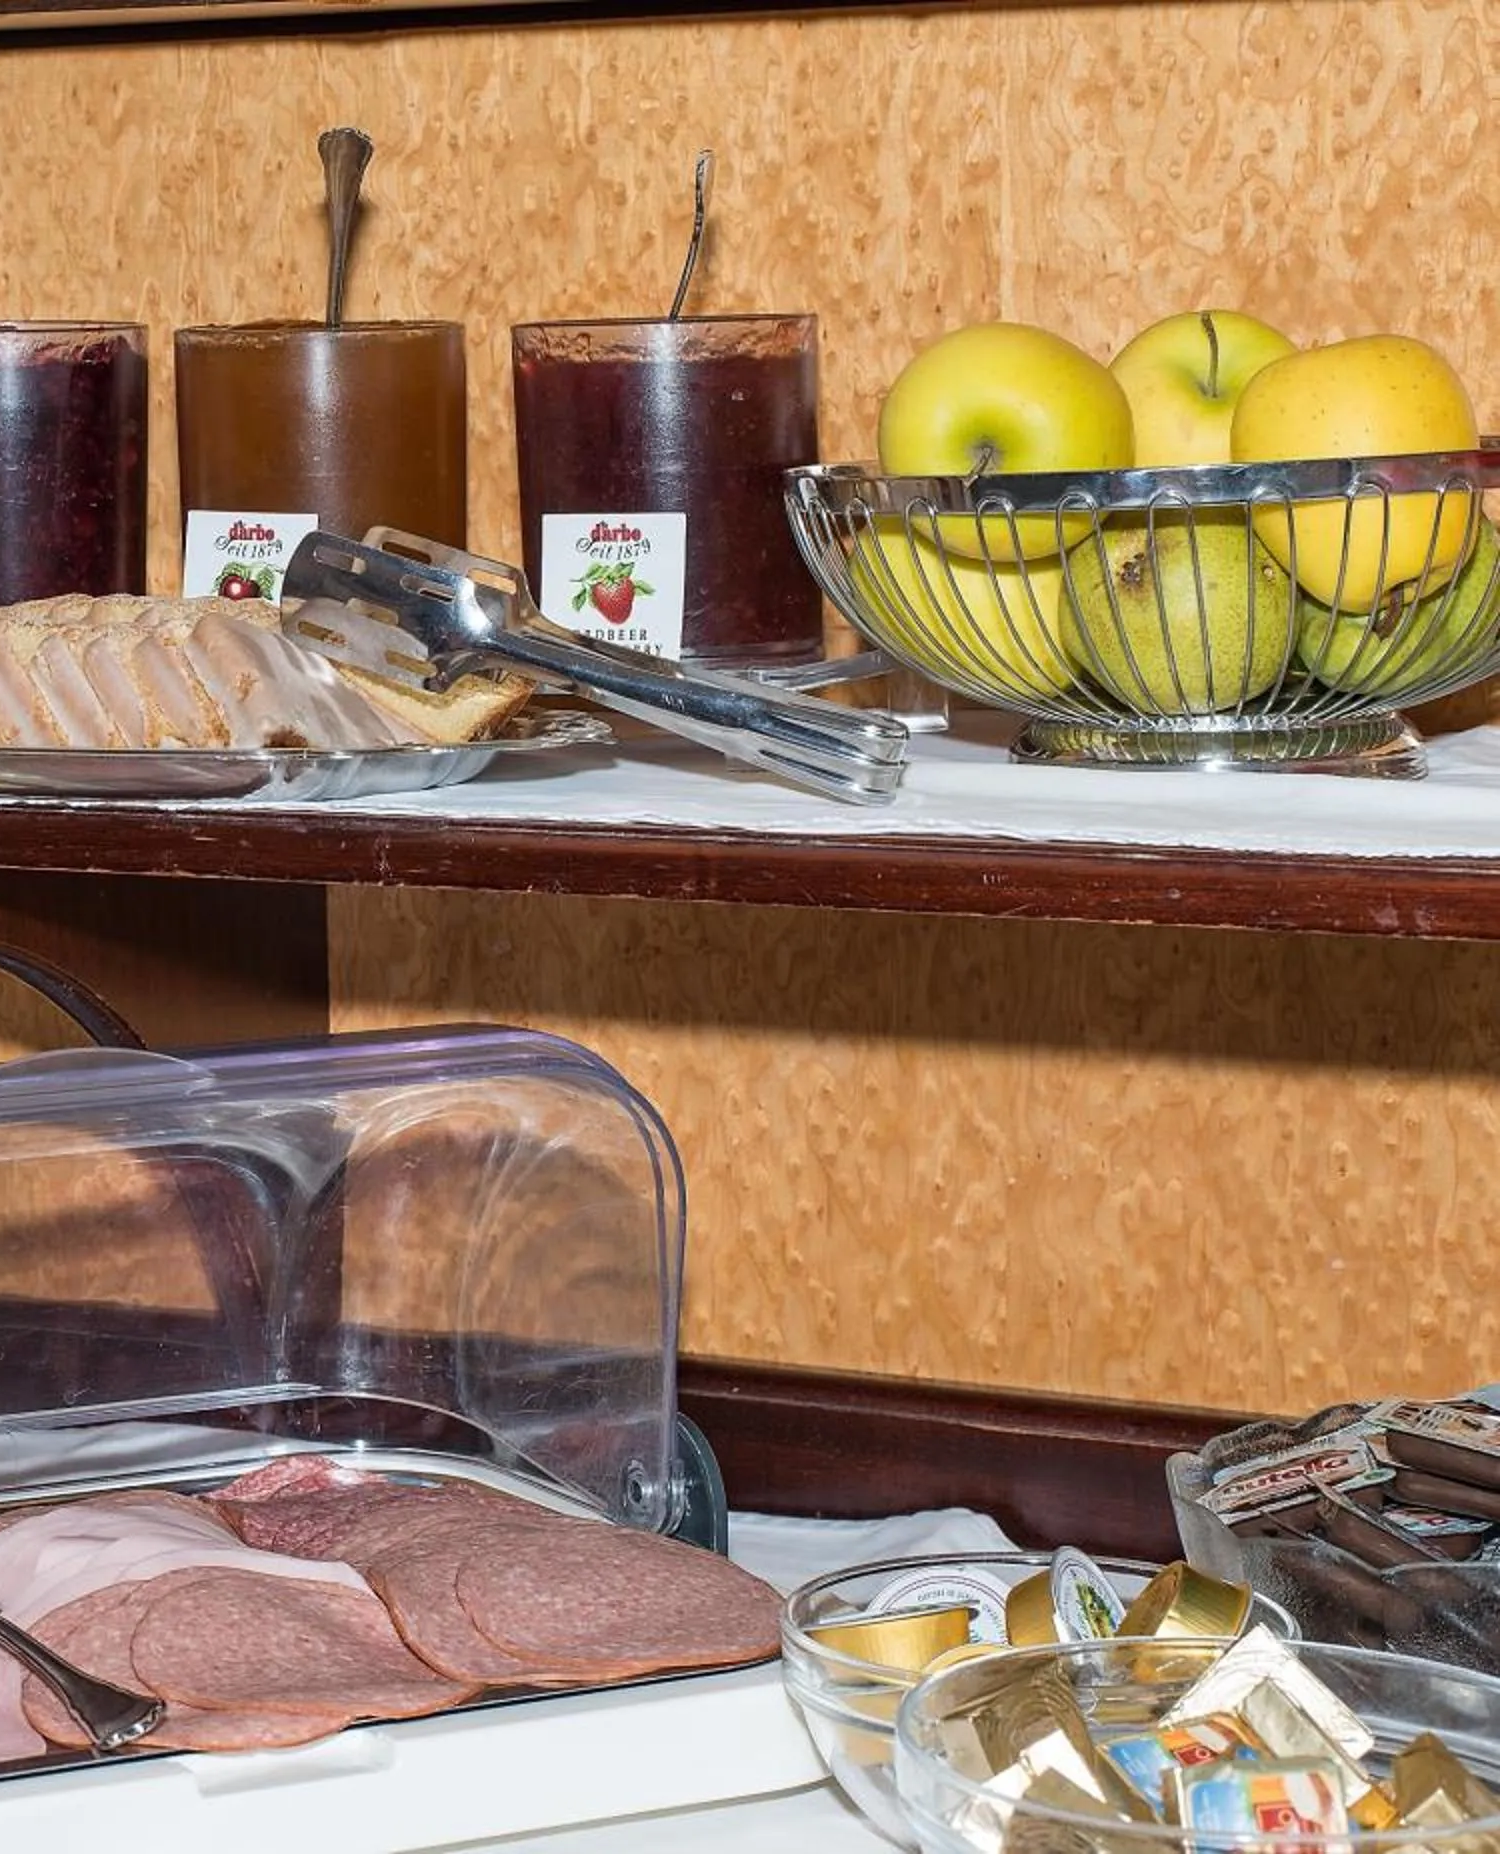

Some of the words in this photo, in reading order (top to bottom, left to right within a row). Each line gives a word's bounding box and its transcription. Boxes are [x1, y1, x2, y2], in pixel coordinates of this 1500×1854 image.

[228, 519, 275, 541] darbo
[589, 519, 642, 542] darbo
[251, 539, 283, 558] 1879
[616, 538, 652, 560] 1879
